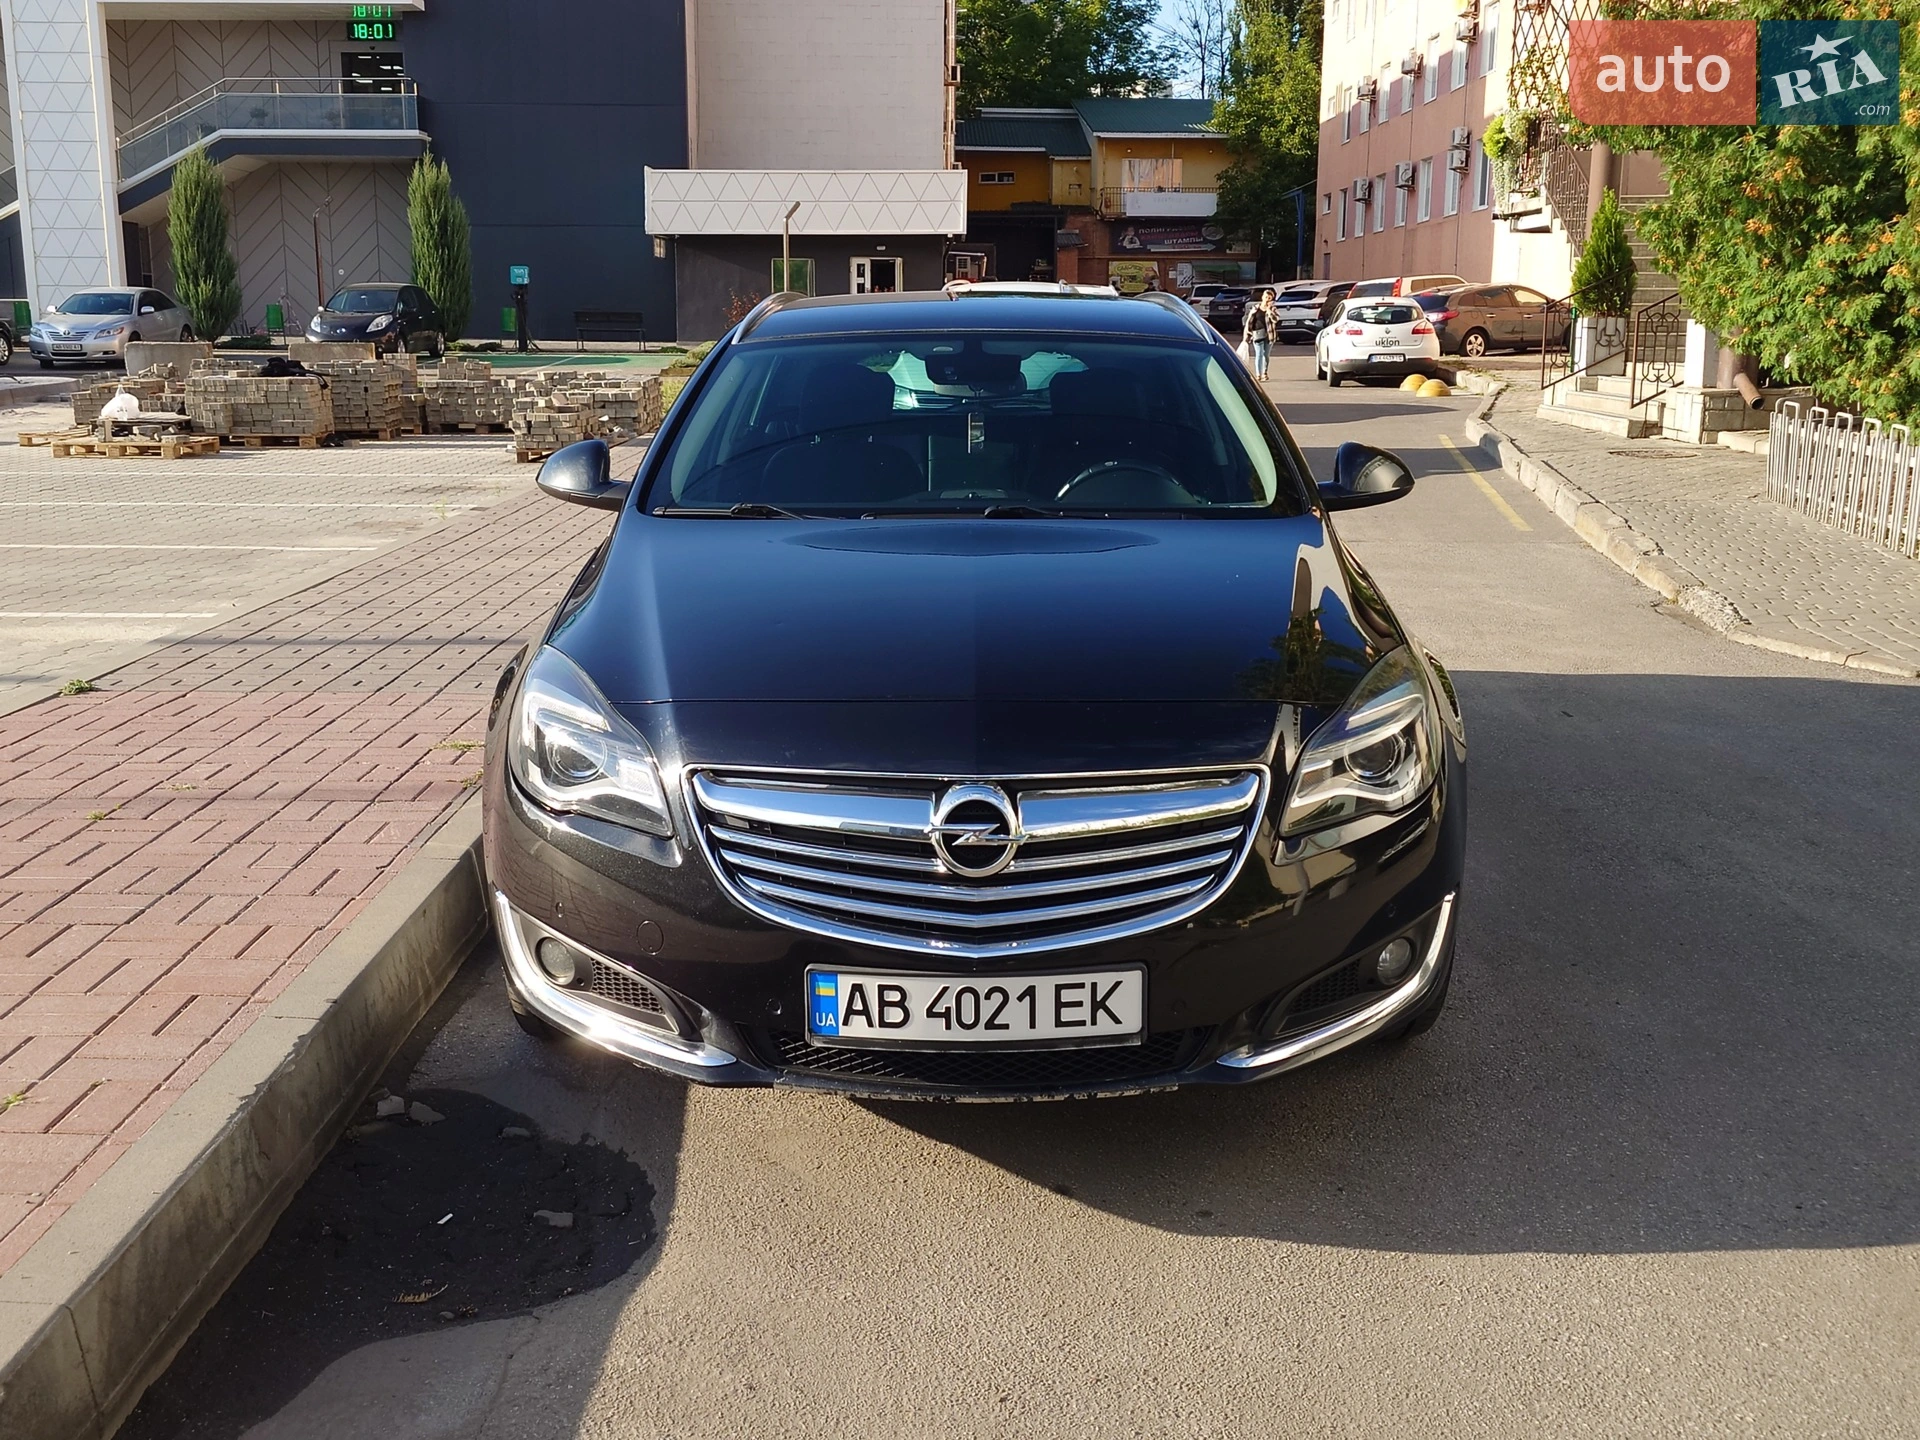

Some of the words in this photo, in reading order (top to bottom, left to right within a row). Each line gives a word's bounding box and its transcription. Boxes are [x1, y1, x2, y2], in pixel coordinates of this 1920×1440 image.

[353, 23, 392, 38] 18:01
[1138, 225, 1196, 234] ПОЛИГ
[1164, 236, 1203, 244] ШТАМПЫ
[1375, 337, 1400, 346] uklon
[842, 983, 911, 1029] AB
[925, 985, 1037, 1031] 4021
[1054, 980, 1124, 1028] EK
[815, 1011, 836, 1028] UA
